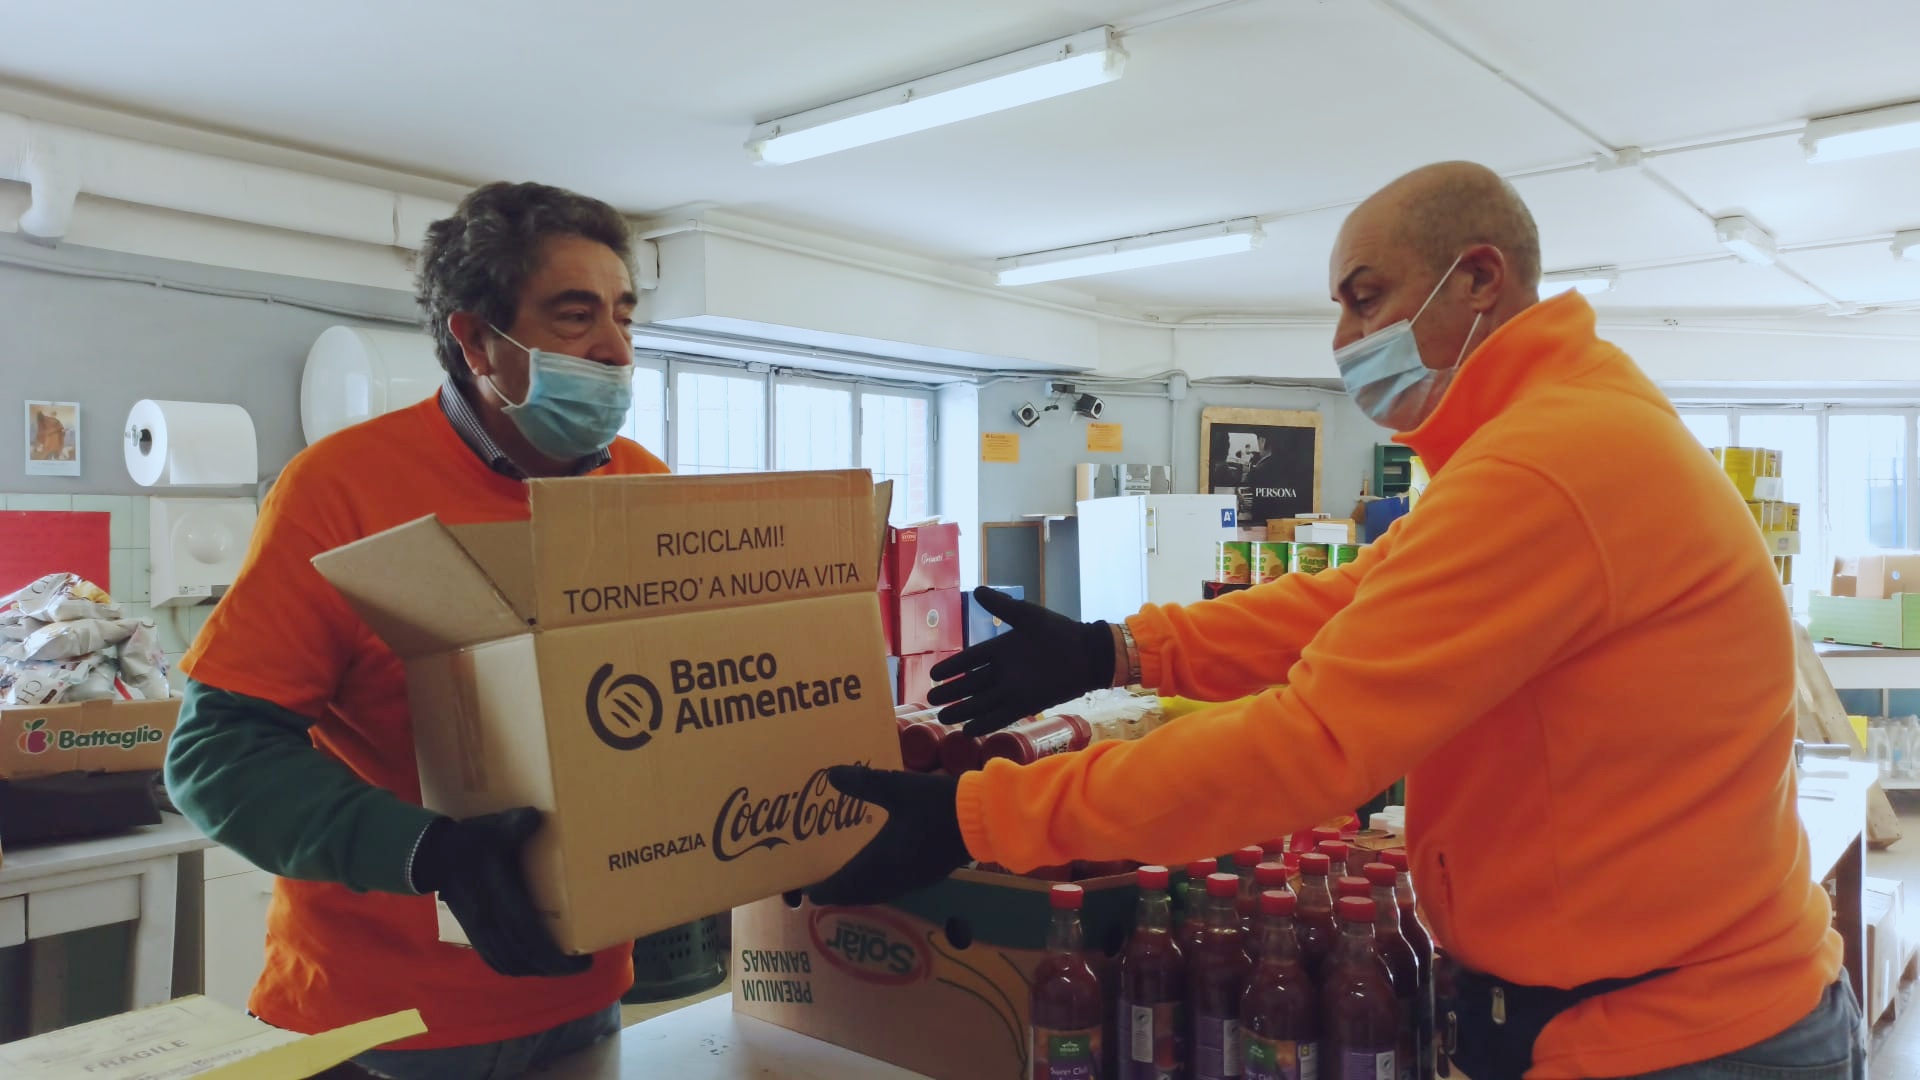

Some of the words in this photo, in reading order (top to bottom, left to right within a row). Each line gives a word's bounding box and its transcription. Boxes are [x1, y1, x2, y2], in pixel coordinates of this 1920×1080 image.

[1255, 487, 1297, 498] PERSONA
[657, 525, 785, 557] RICICLAMI!
[564, 577, 704, 615] TORNERO'
[709, 576, 726, 599] A
[731, 567, 810, 597] NUOVA
[814, 562, 860, 587] VITA
[670, 652, 777, 694] Banco
[675, 674, 861, 734] Alimentare
[58, 725, 163, 749] Battaglio
[608, 832, 706, 872] RINGRAZIA
[742, 950, 812, 973] BANANAS
[742, 979, 814, 1004] PREMIUM
[83, 1039, 189, 1073] FRAGILE
